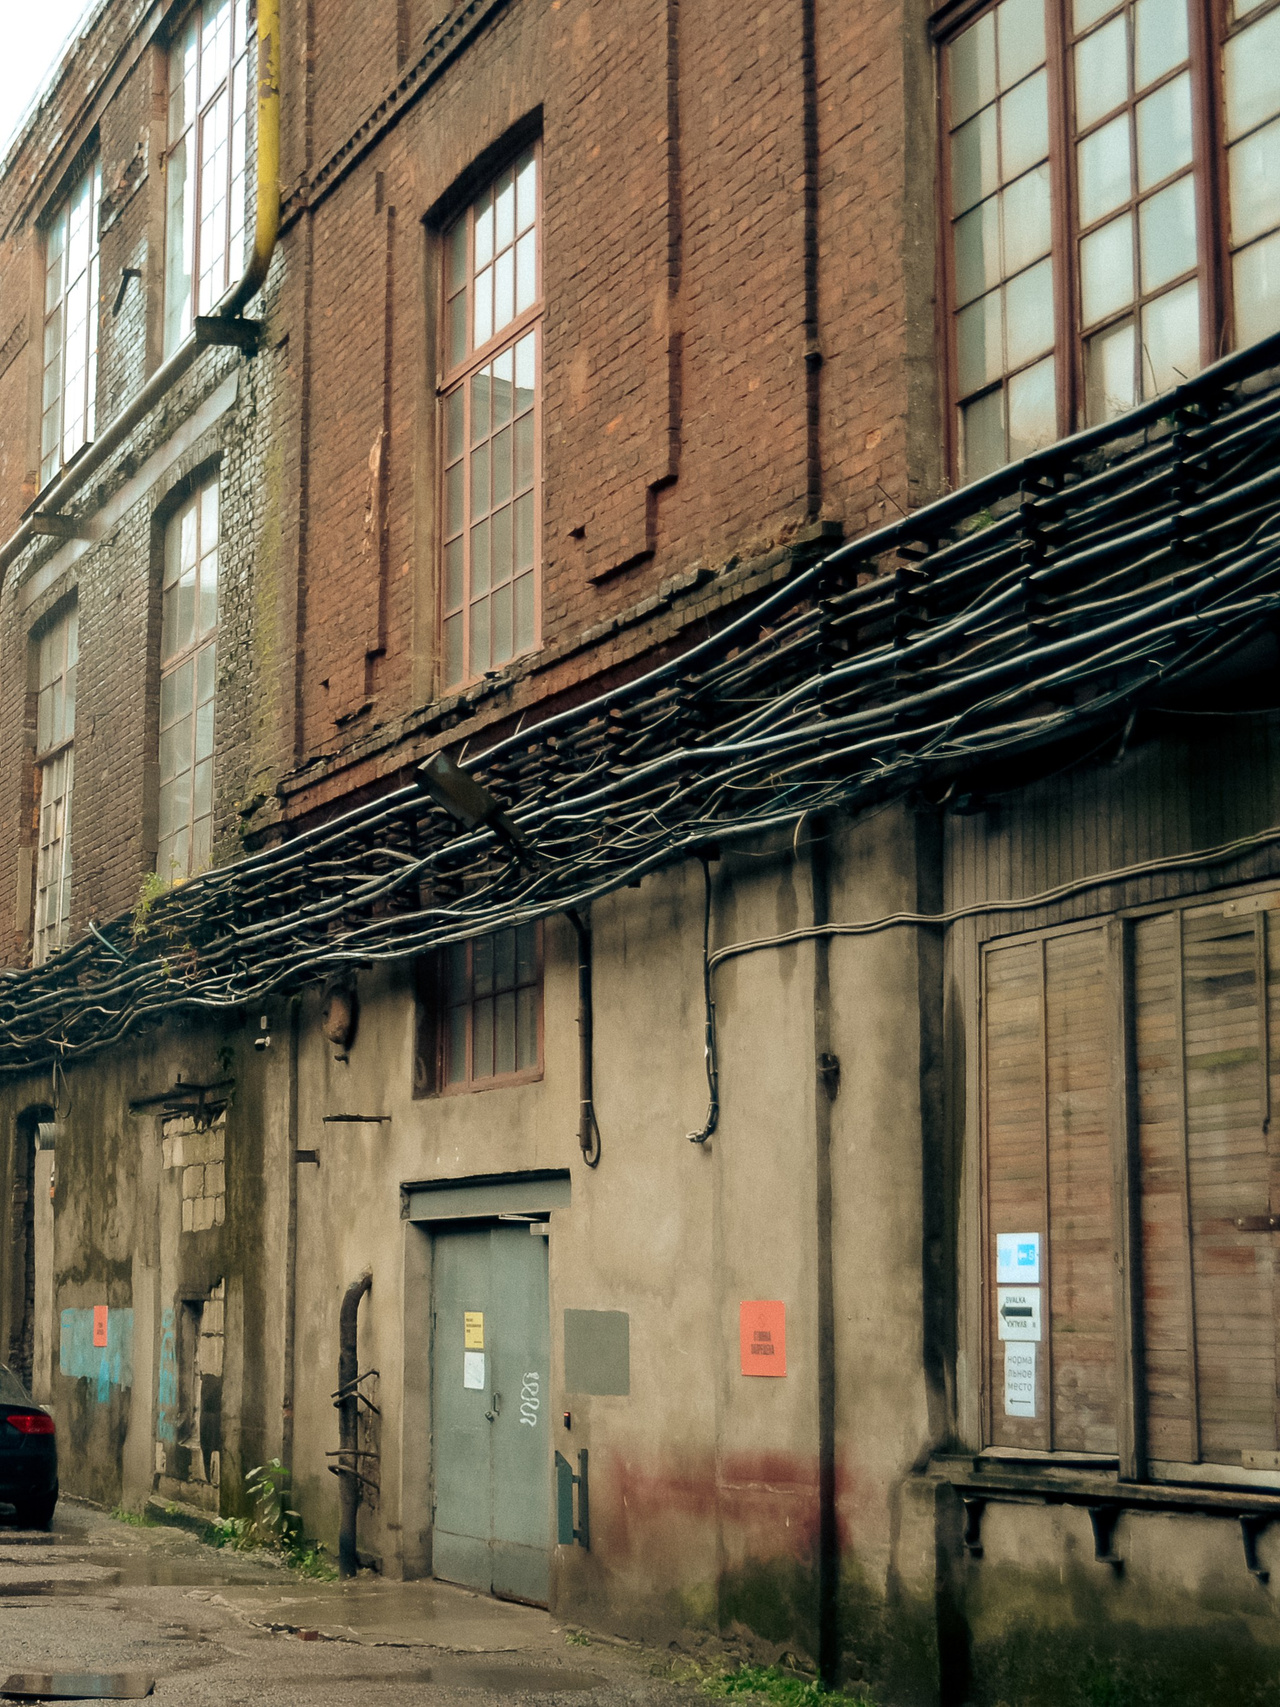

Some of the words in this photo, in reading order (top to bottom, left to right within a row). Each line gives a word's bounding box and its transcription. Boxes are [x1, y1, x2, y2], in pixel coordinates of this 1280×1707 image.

[1007, 1355, 1033, 1366] норма
[1007, 1369, 1033, 1379] льное
[1007, 1382, 1033, 1392] место
